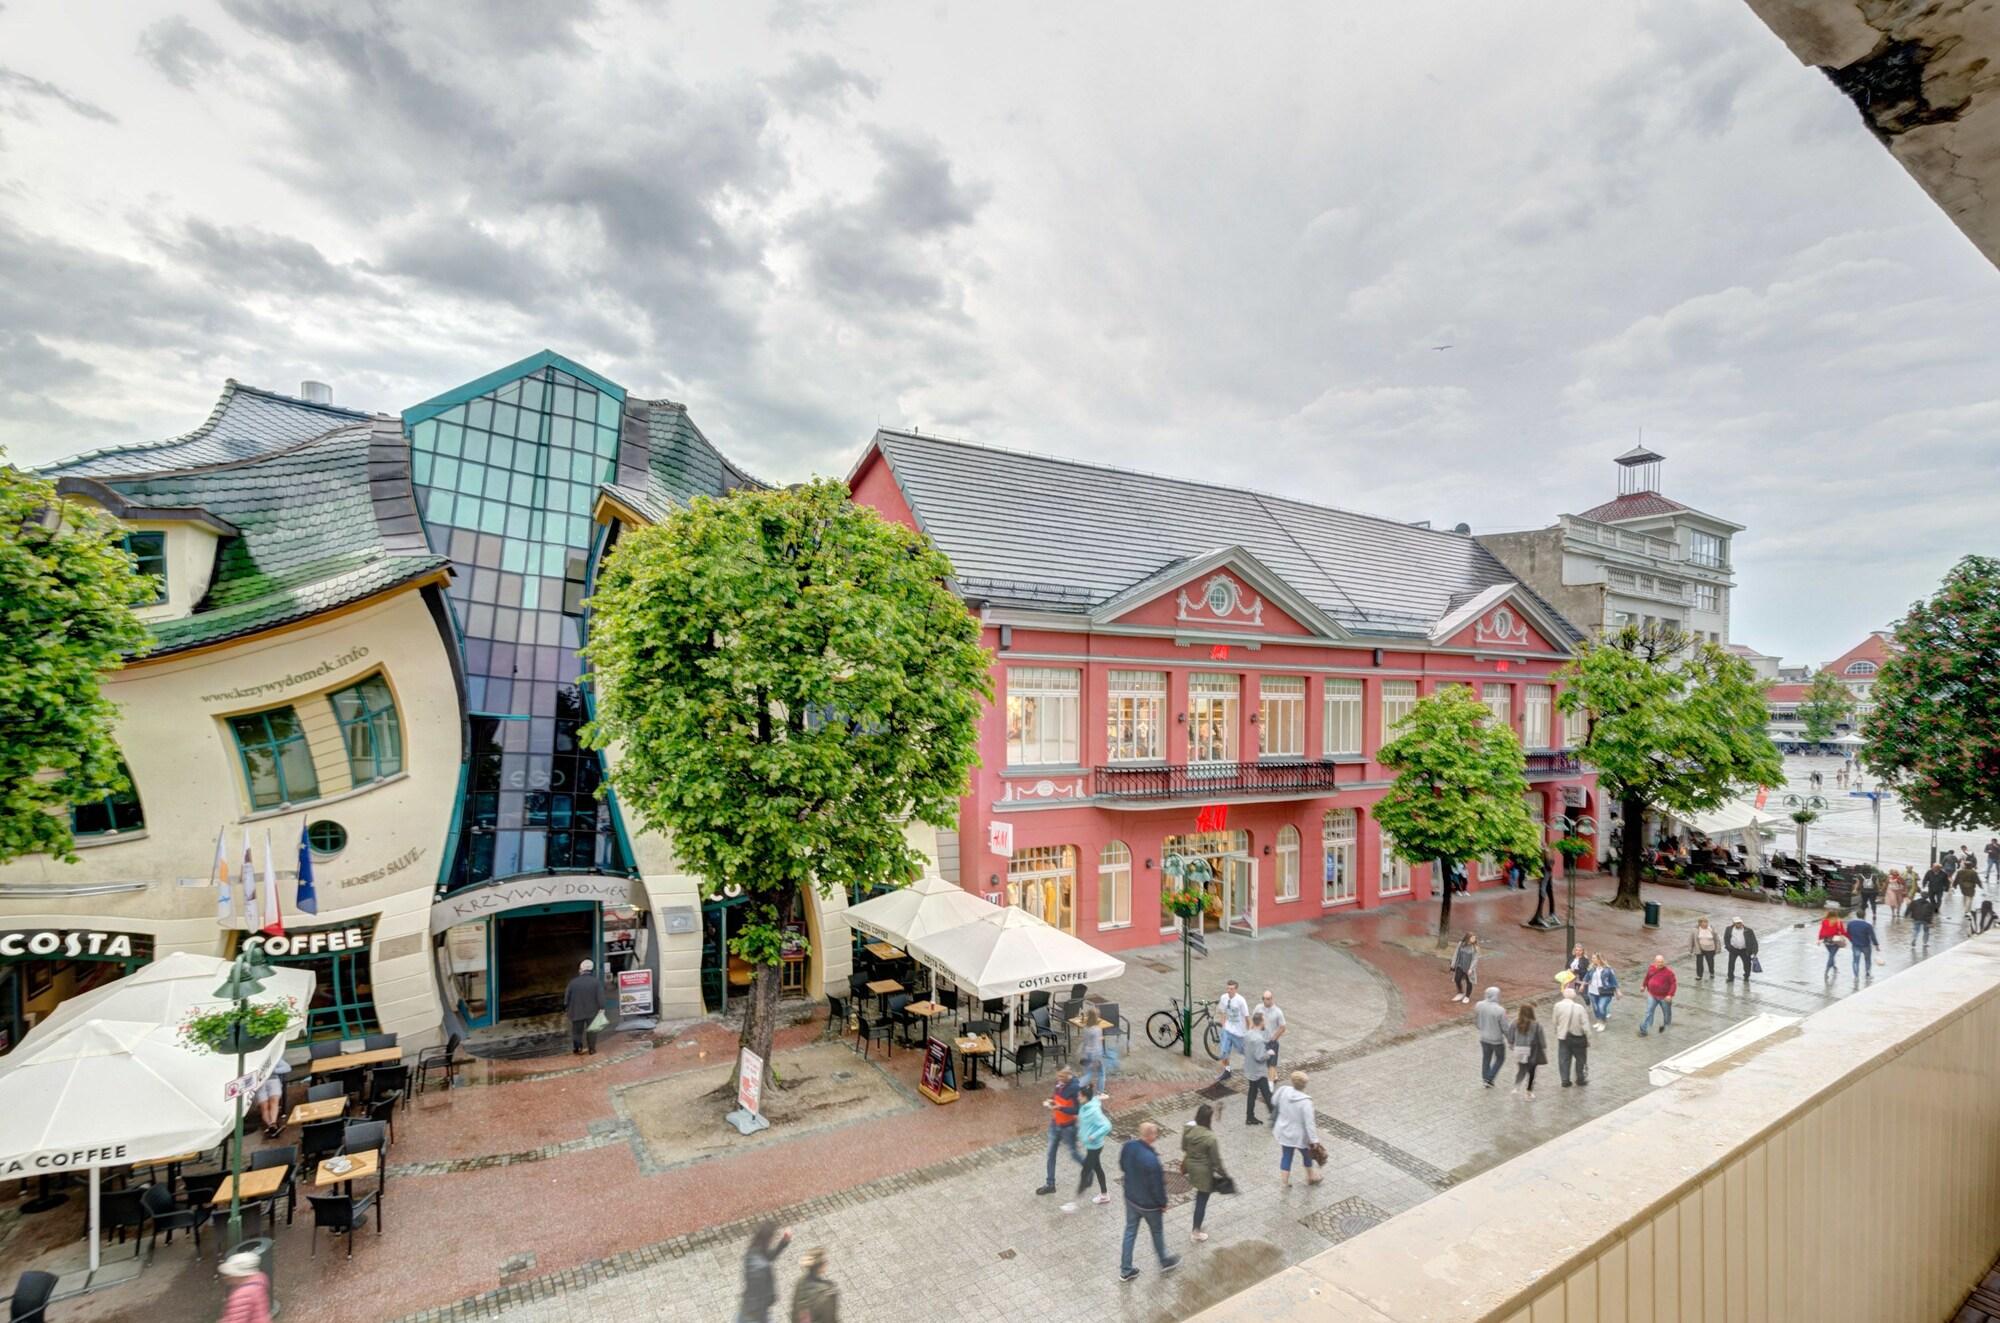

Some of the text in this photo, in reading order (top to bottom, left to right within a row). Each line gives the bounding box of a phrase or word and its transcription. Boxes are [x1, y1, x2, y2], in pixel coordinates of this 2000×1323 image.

[201, 645, 369, 703] www.krzywydomek.info
[453, 883, 628, 917] KRZYWY DOMEK
[0, 928, 364, 957] COSTA COFFEE
[1018, 971, 1088, 988] COSTA COFFEE
[35, 1145, 127, 1168] COFFEE
